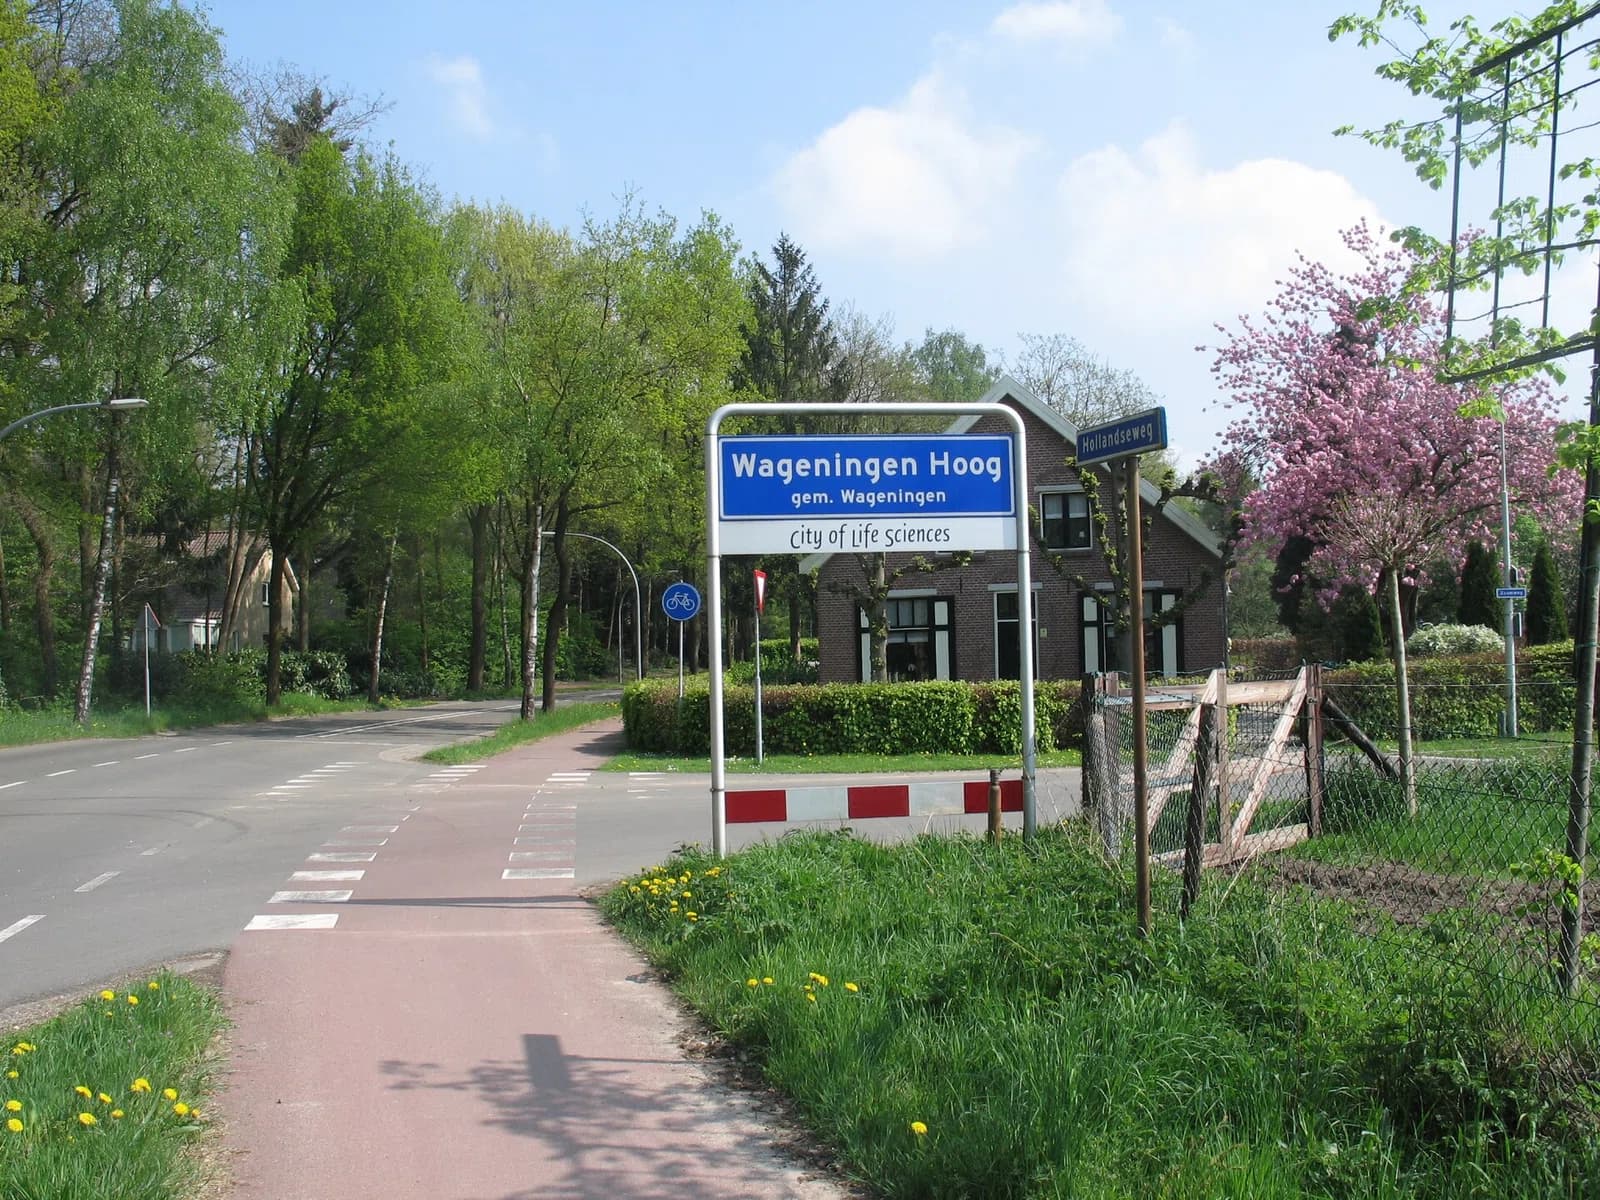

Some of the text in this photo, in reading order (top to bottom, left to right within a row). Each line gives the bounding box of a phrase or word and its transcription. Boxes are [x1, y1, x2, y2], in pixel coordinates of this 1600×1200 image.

[1082, 423, 1153, 453] Hollandseweg
[731, 451, 1001, 484] Wageningen Hoog
[791, 489, 946, 508] gem. Wageningen
[790, 524, 822, 549] City
[828, 523, 848, 549] of
[852, 523, 879, 548] Life
